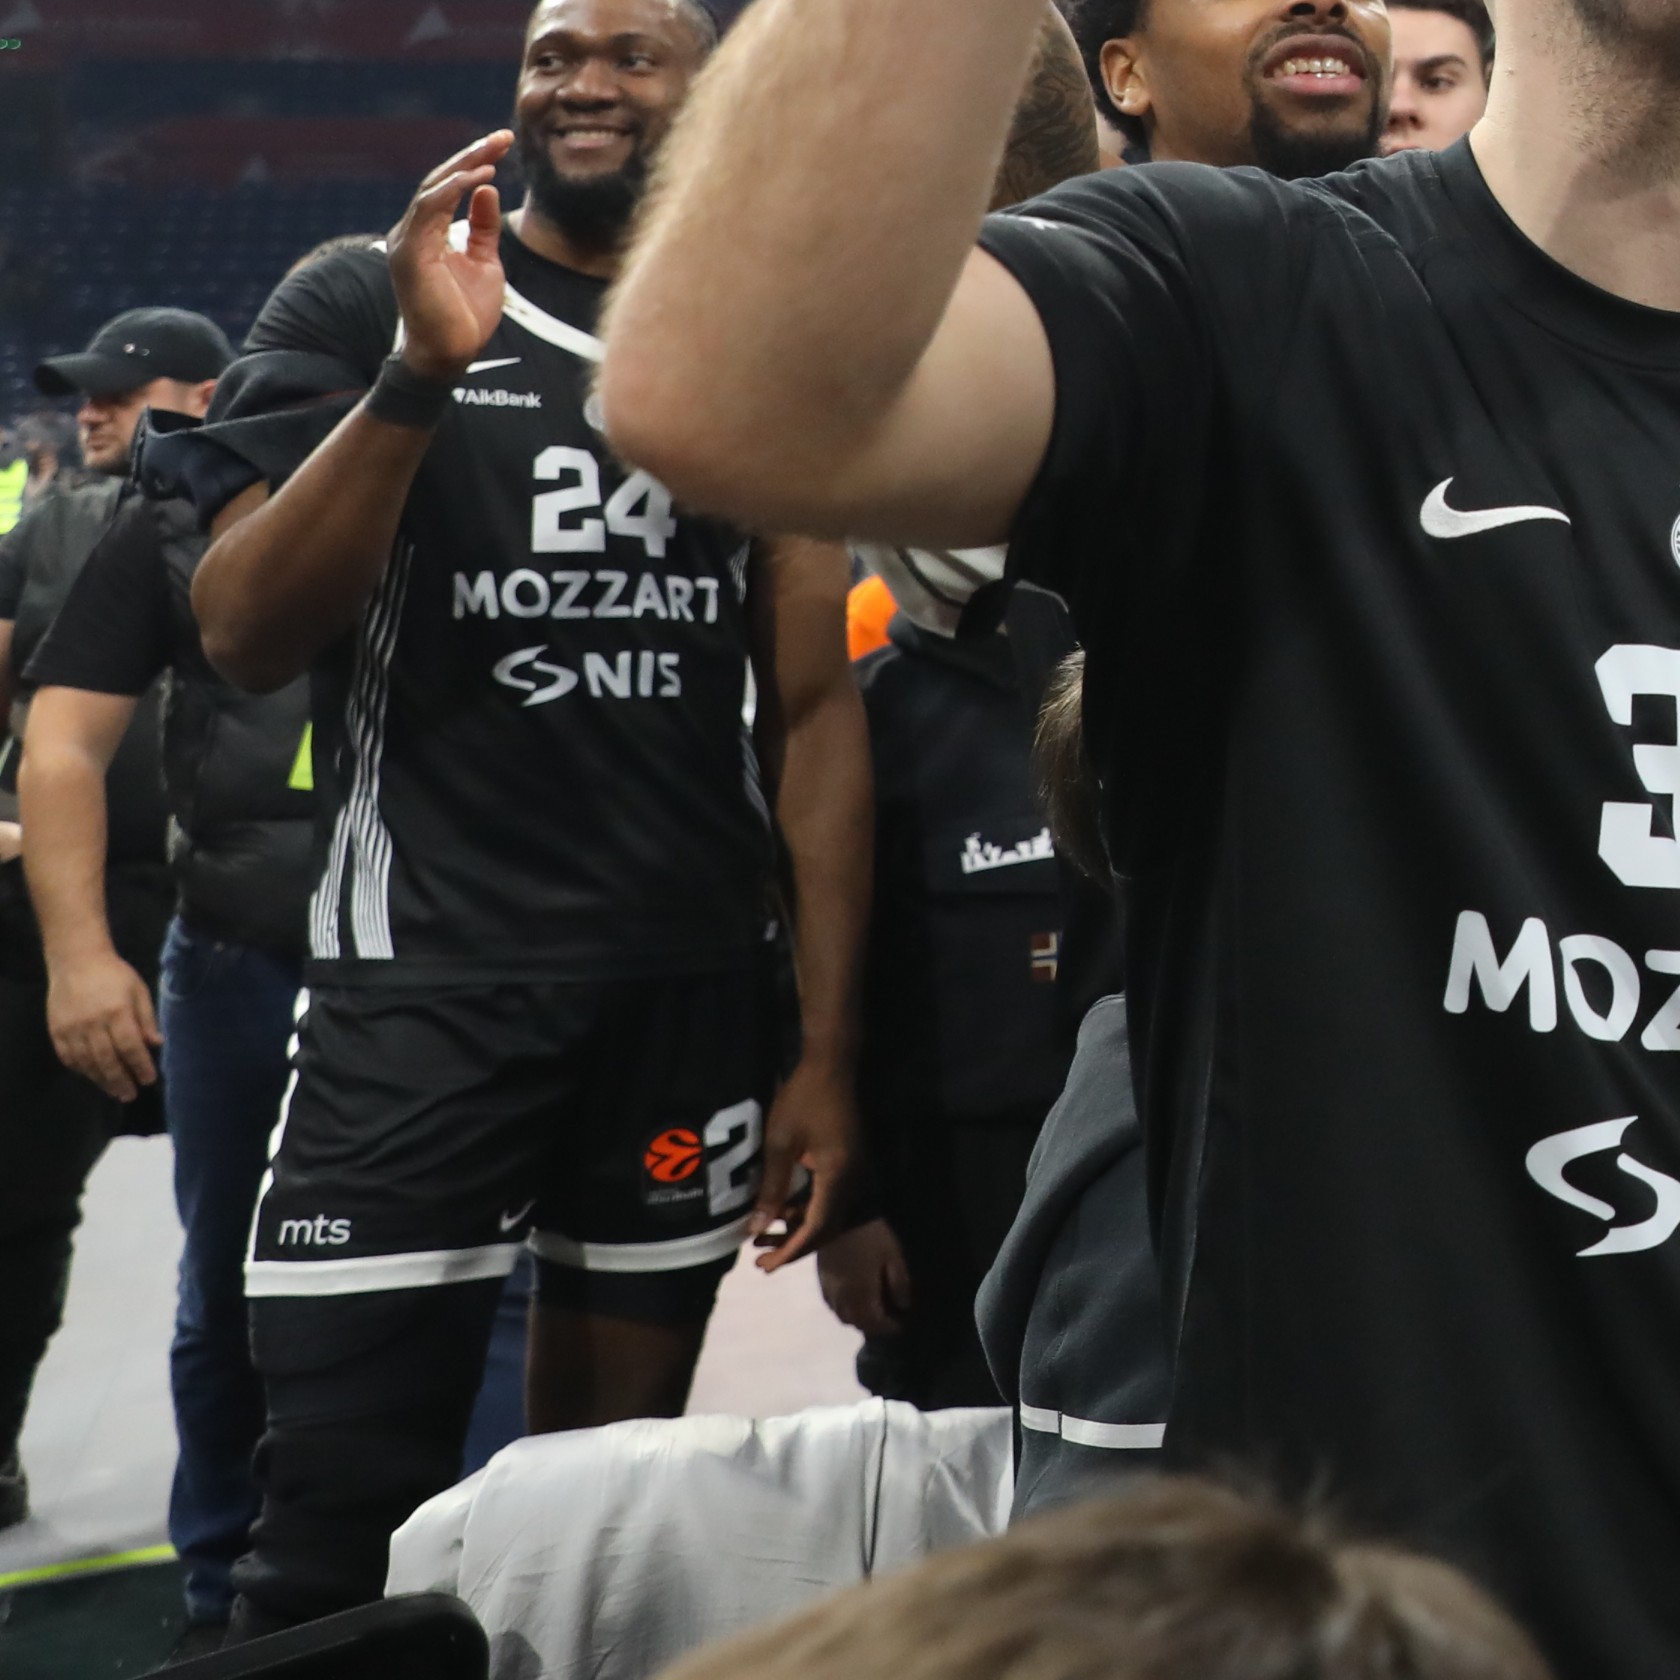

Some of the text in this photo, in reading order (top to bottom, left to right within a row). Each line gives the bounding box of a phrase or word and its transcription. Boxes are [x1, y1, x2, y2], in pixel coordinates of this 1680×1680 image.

[531, 445, 677, 558] 24
[452, 568, 719, 622] MOZZART
[583, 651, 682, 699] NIS
[278, 1213, 351, 1246] mts
